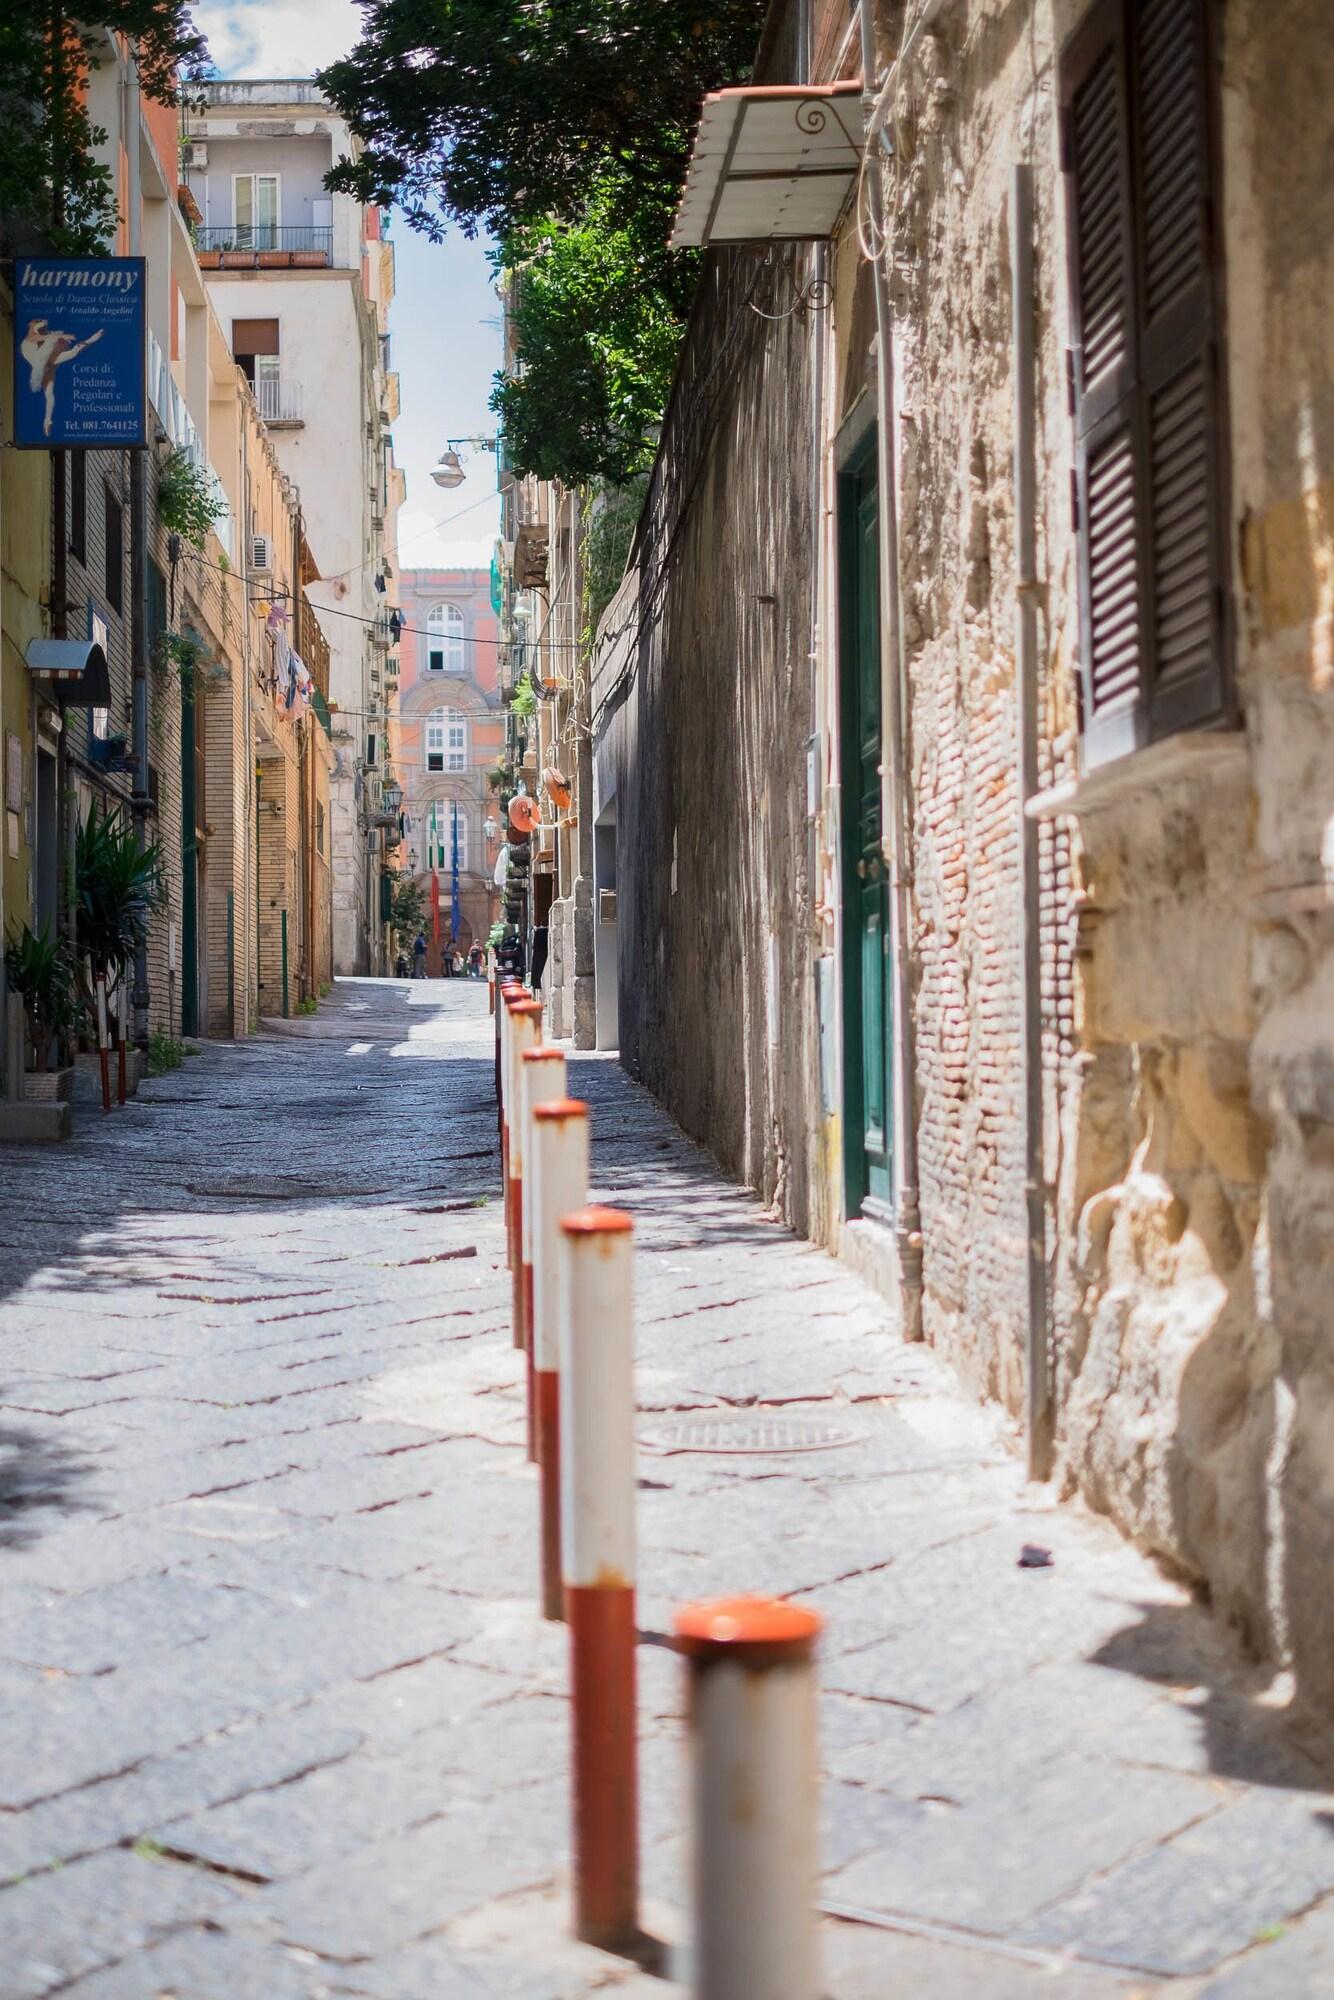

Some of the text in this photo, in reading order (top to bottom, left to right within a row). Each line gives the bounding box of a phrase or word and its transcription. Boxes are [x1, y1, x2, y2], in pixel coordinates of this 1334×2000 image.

[22, 264, 138, 293] harmony
[72, 363, 98, 373] Corsi
[73, 377, 117, 387] Predanza
[73, 389, 113, 402] Regolari
[73, 402, 135, 413] Professionali
[64, 420, 139, 430] Tel. 081.7641125
